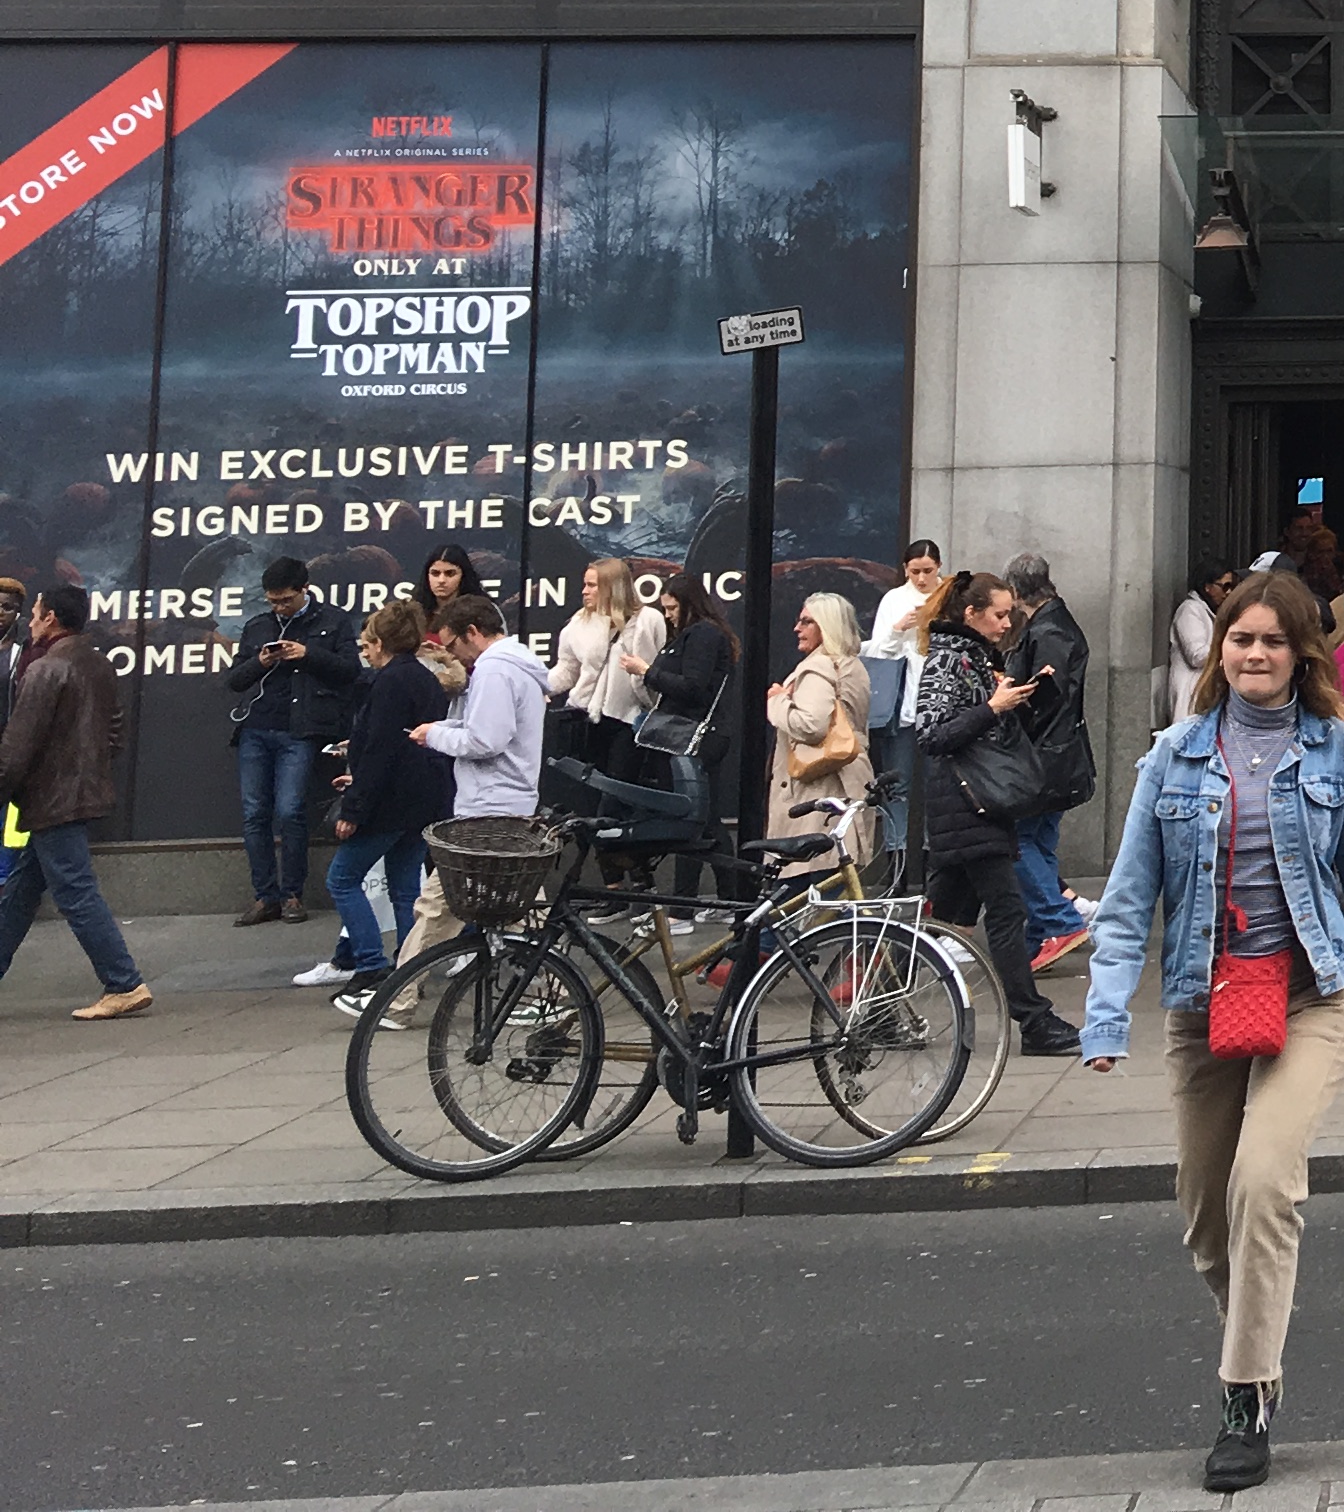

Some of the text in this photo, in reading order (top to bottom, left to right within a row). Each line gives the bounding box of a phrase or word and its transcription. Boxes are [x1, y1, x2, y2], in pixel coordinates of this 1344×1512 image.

[87, 88, 165, 155] NOW
[372, 116, 453, 138] NETFLIX
[334, 147, 490, 158] A NETFLIX ORIGINAL SERIES
[288, 171, 534, 218] STRANGER
[329, 214, 494, 252] THINGS
[353, 257, 467, 276] ONLY AT
[285, 294, 532, 349] TOPSHOP
[727, 328, 797, 347] at any time
[318, 341, 487, 377] TOPMAN
[341, 383, 468, 397] OXFORD CIRCUS
[106, 439, 690, 483] WIN EXCLUSIVE T-SHIRTS
[151, 494, 641, 538] SIGNED BY THE CAST
[89, 586, 244, 621] MERSE
